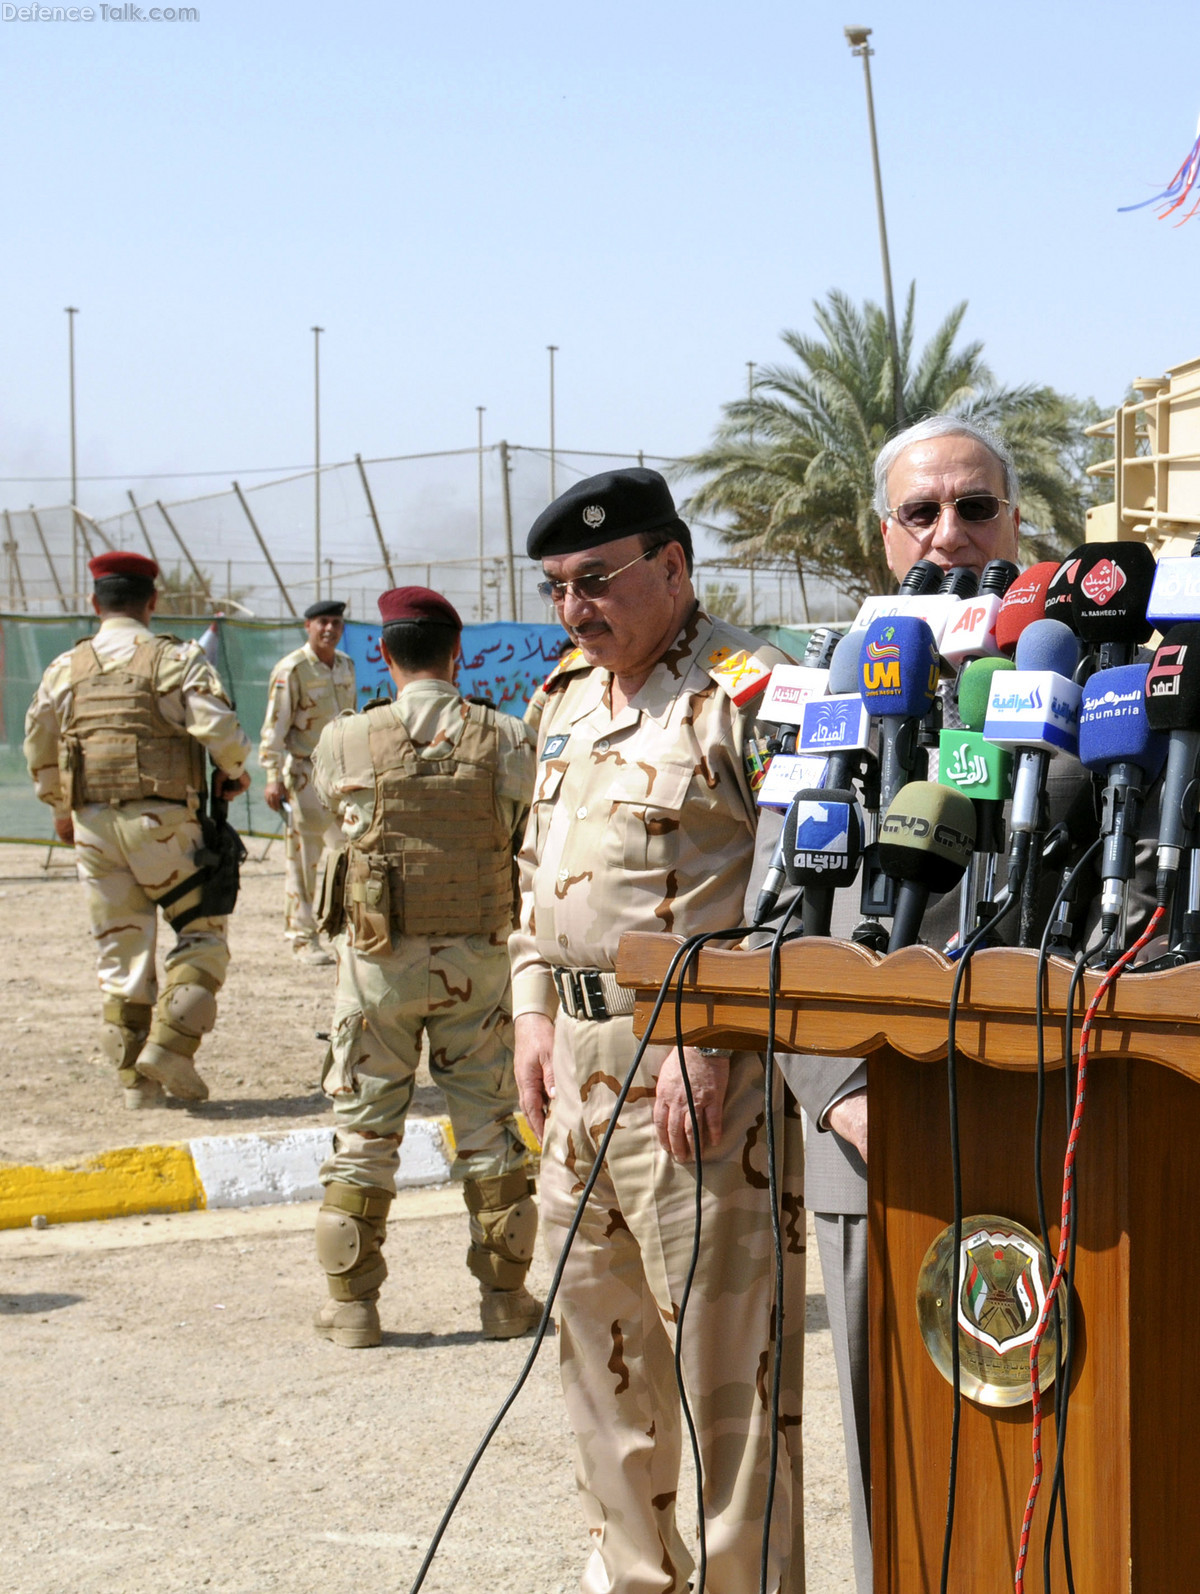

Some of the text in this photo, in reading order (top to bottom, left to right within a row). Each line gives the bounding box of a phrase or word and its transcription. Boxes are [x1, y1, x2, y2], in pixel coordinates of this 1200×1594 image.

[951, 606, 987, 634] AP
[863, 661, 900, 690] UM
[992, 684, 1043, 713] العراقية
[1080, 705, 1139, 724] alsumaria
[793, 853, 848, 873] الاتجاه
